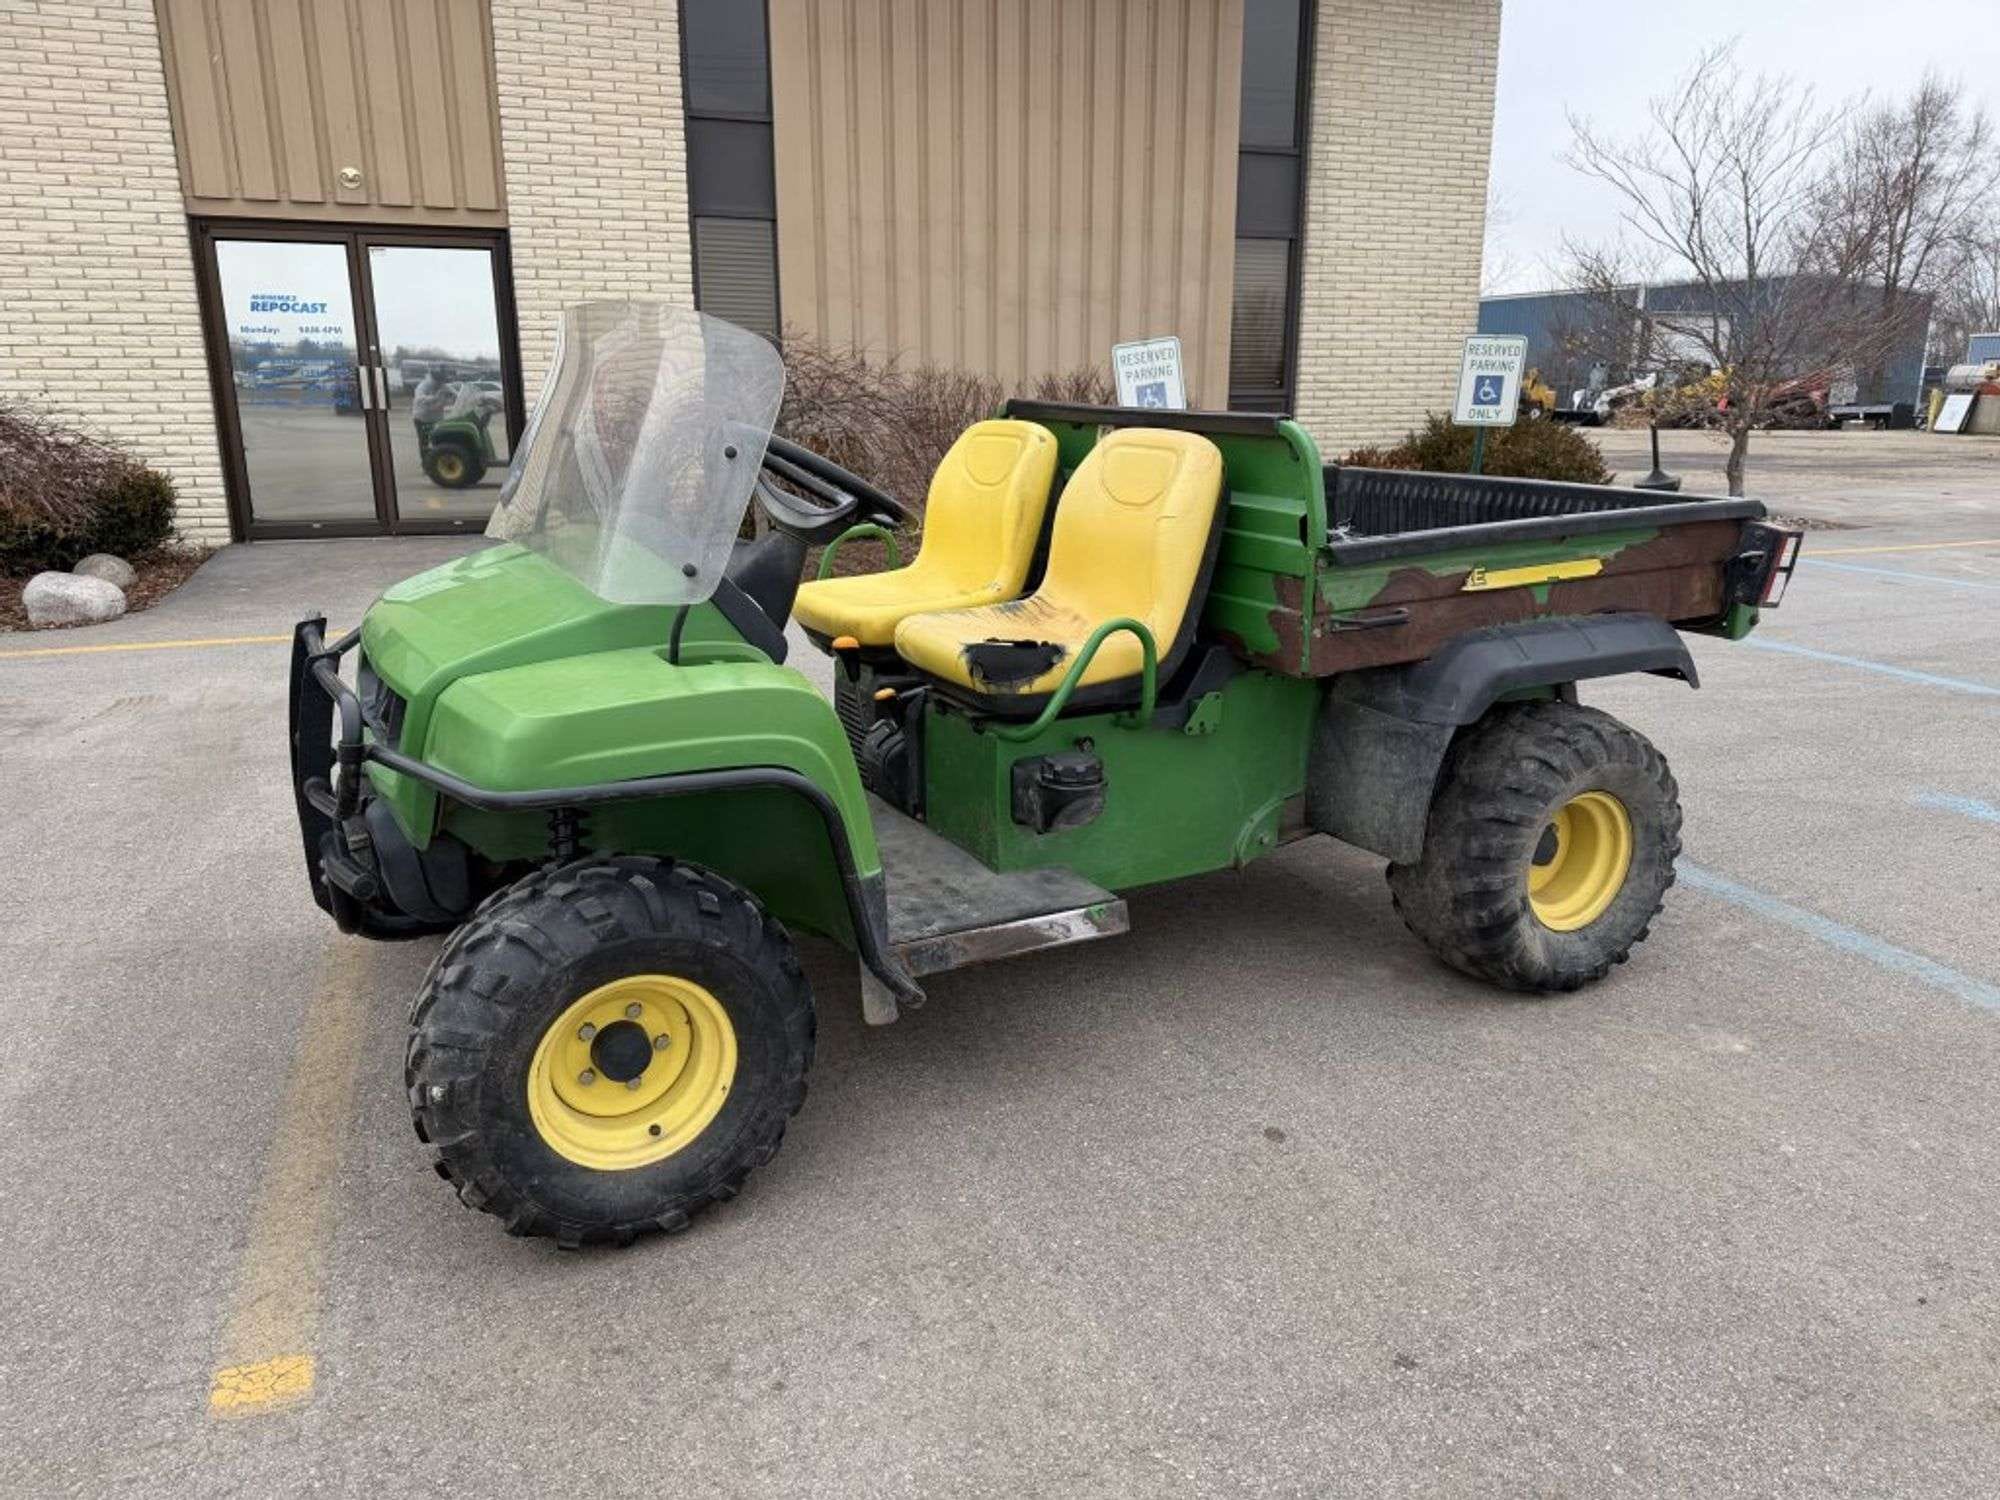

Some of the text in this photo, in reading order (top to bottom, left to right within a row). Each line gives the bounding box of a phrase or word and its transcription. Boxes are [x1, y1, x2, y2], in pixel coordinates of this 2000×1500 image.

[250, 301, 328, 314] REPOCAST
[1120, 347, 1175, 366] RESERVED
[1468, 343, 1521, 357] RESERVED
[1469, 359, 1516, 373] PARKING
[1125, 364, 1173, 383] PARKING
[1467, 408, 1503, 419] ONLY
